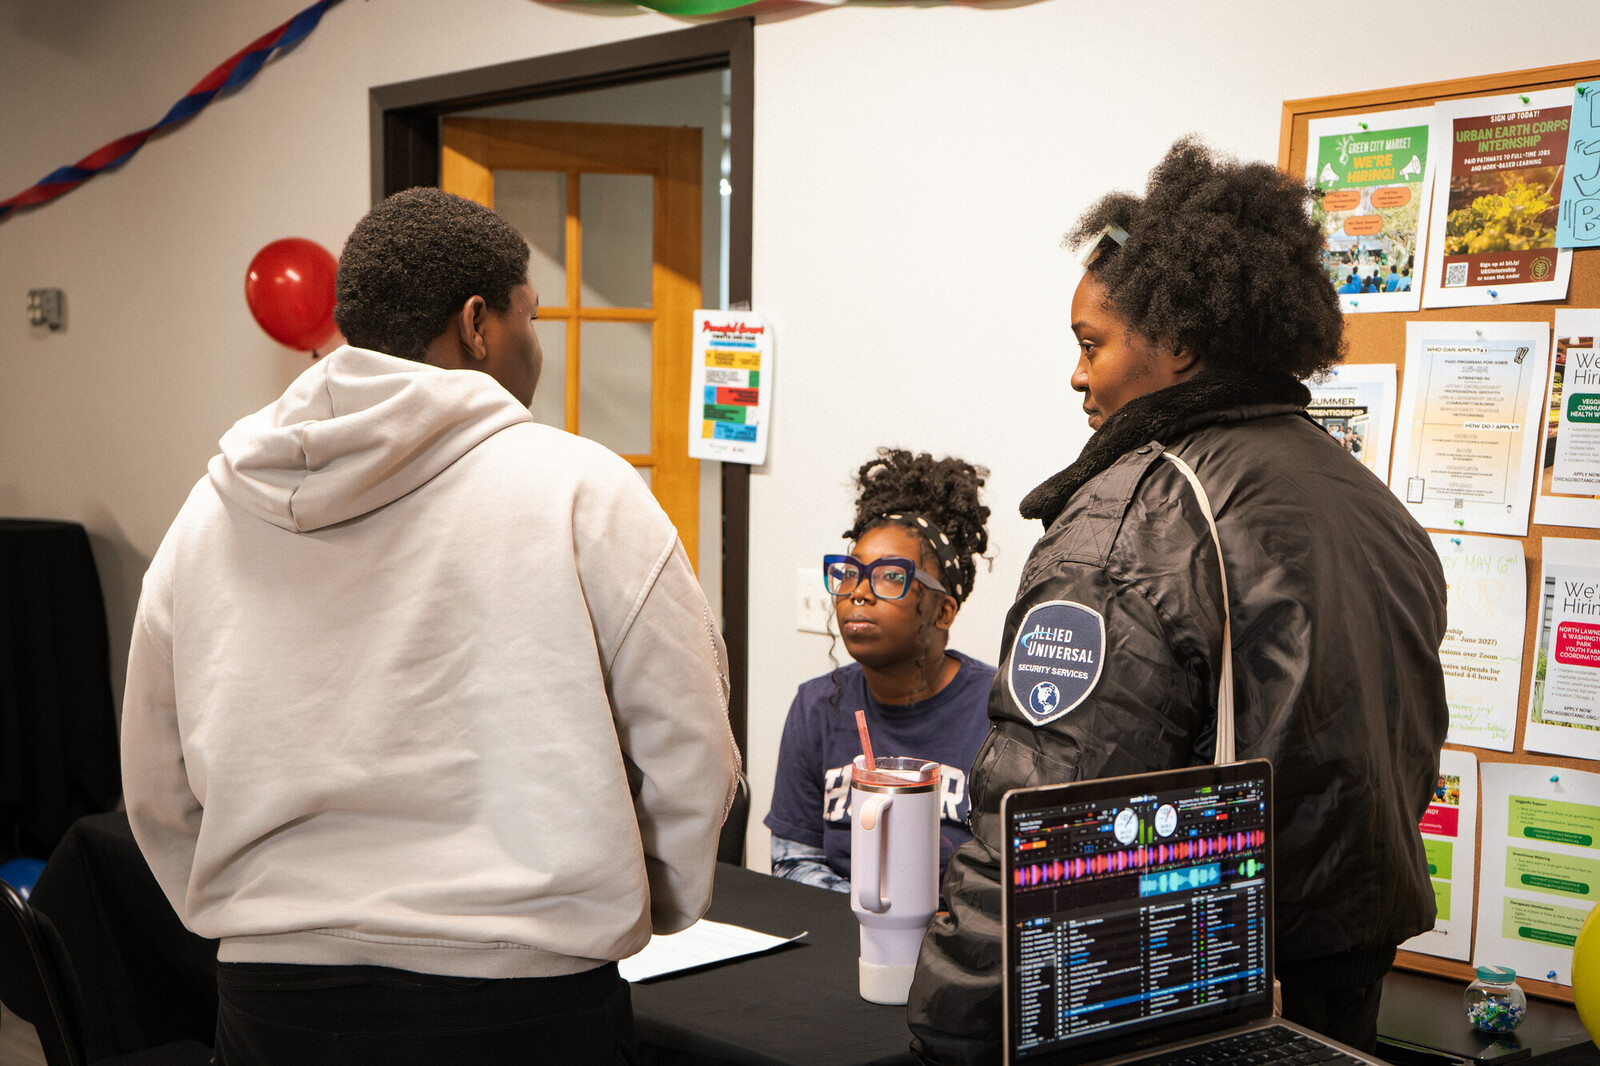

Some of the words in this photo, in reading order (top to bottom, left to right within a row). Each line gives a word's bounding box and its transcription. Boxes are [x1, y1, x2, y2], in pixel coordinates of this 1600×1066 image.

[1490, 114, 1506, 122] SIGN
[1517, 110, 1540, 120] TODAY!
[1456, 128, 1493, 142] URBAN
[1495, 123, 1530, 138] EARTH
[1532, 119, 1569, 134] CORPS
[1349, 141, 1368, 154] GREEN
[1370, 140, 1384, 152] CITY
[1385, 137, 1411, 151] MARKET
[1478, 134, 1541, 153] INTERNSHIP
[1353, 154, 1393, 169] WE'RE
[1477, 155, 1502, 164] PATHWAYS
[1511, 151, 1536, 159] FULL-TIME
[1482, 162, 1515, 171] WORK-BASED
[1516, 159, 1541, 167] LEARNING
[1347, 168, 1396, 183] HIRING!
[1464, 554, 1492, 574] MAY
[1031, 624, 1073, 643] ALLIED
[1478, 638, 1497, 646] 2027)
[1027, 641, 1094, 663] UNIVERSAL
[1018, 664, 1051, 674] SECURITY
[1051, 668, 1089, 680] SERVICES
[1461, 664, 1488, 673] stipends
